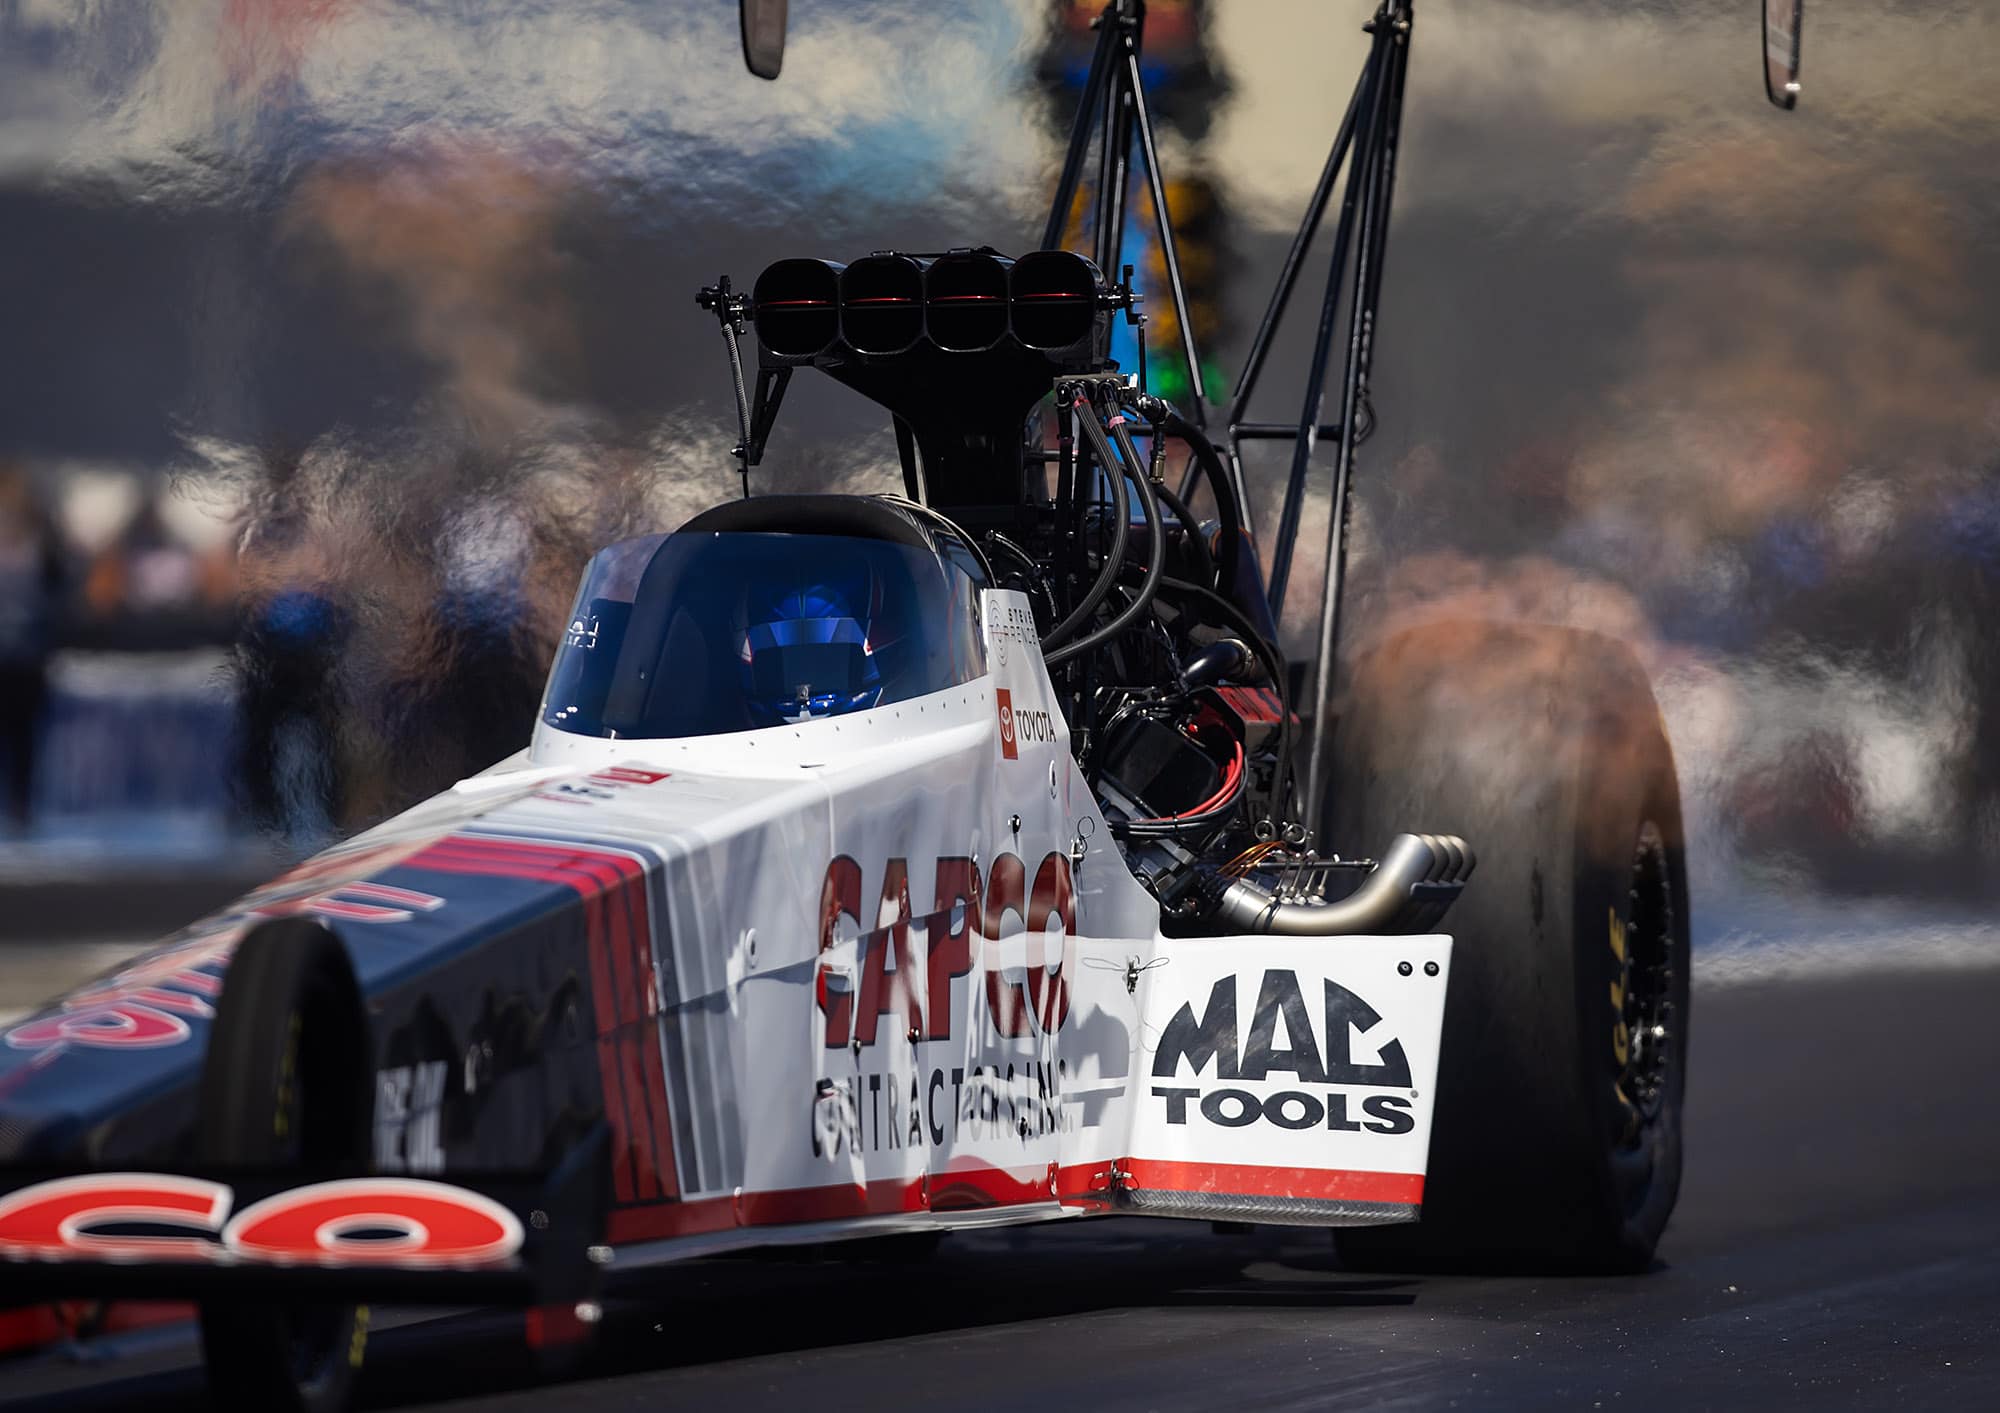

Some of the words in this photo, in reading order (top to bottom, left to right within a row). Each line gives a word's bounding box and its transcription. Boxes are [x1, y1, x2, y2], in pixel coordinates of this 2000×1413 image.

[1015, 710, 1057, 743] TOYOTA
[816, 851, 1077, 1049] CAPCO
[1151, 969, 1413, 1089] MAC
[1151, 1086, 1415, 1135] TOOLS
